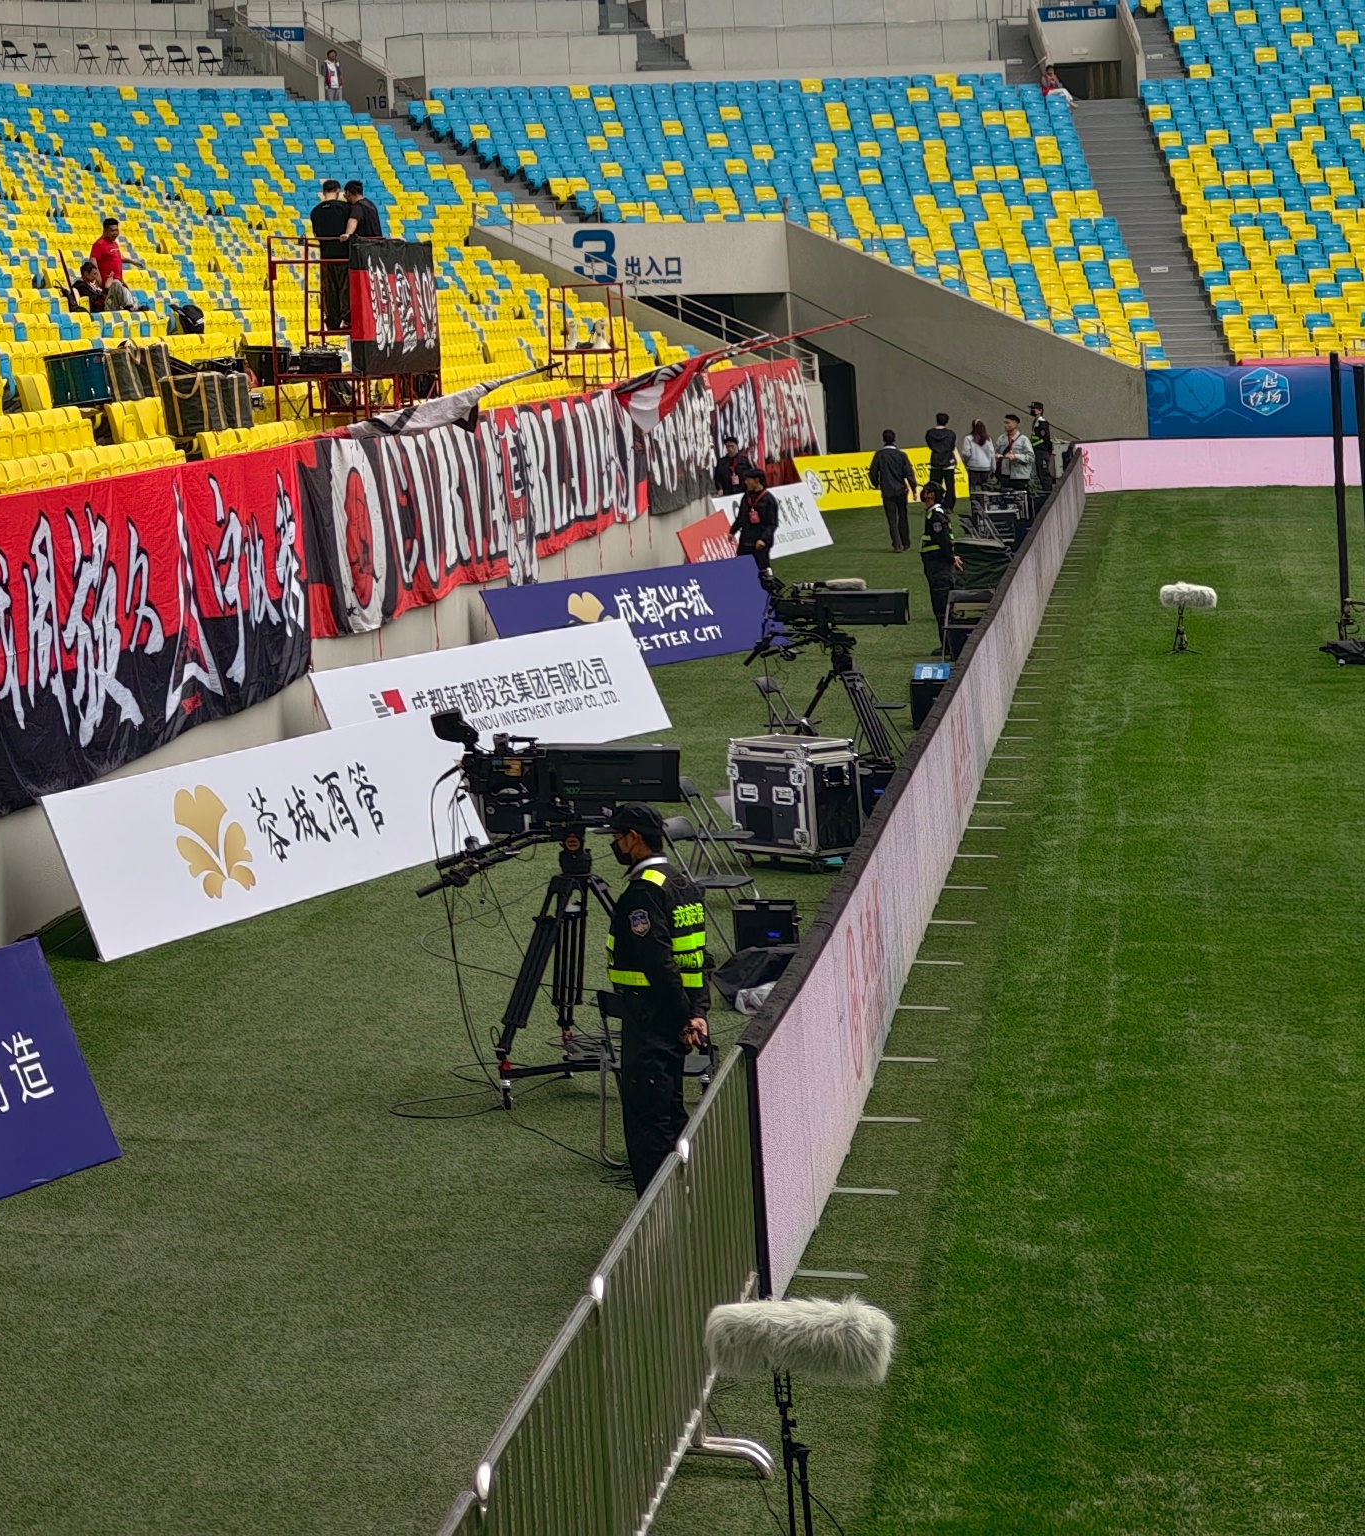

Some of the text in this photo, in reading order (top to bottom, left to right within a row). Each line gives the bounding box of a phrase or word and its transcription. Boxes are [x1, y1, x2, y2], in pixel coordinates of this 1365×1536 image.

[365, 95, 387, 110] 116
[572, 229, 682, 284] 3 出入口
[613, 578, 714, 630] 成都兴城
[693, 624, 723, 646] CITY
[500, 705, 555, 728] INVESTMENT
[554, 699, 586, 715] GROUP
[603, 689, 622, 704] LTD.
[247, 761, 386, 865] 蓉城酒管
